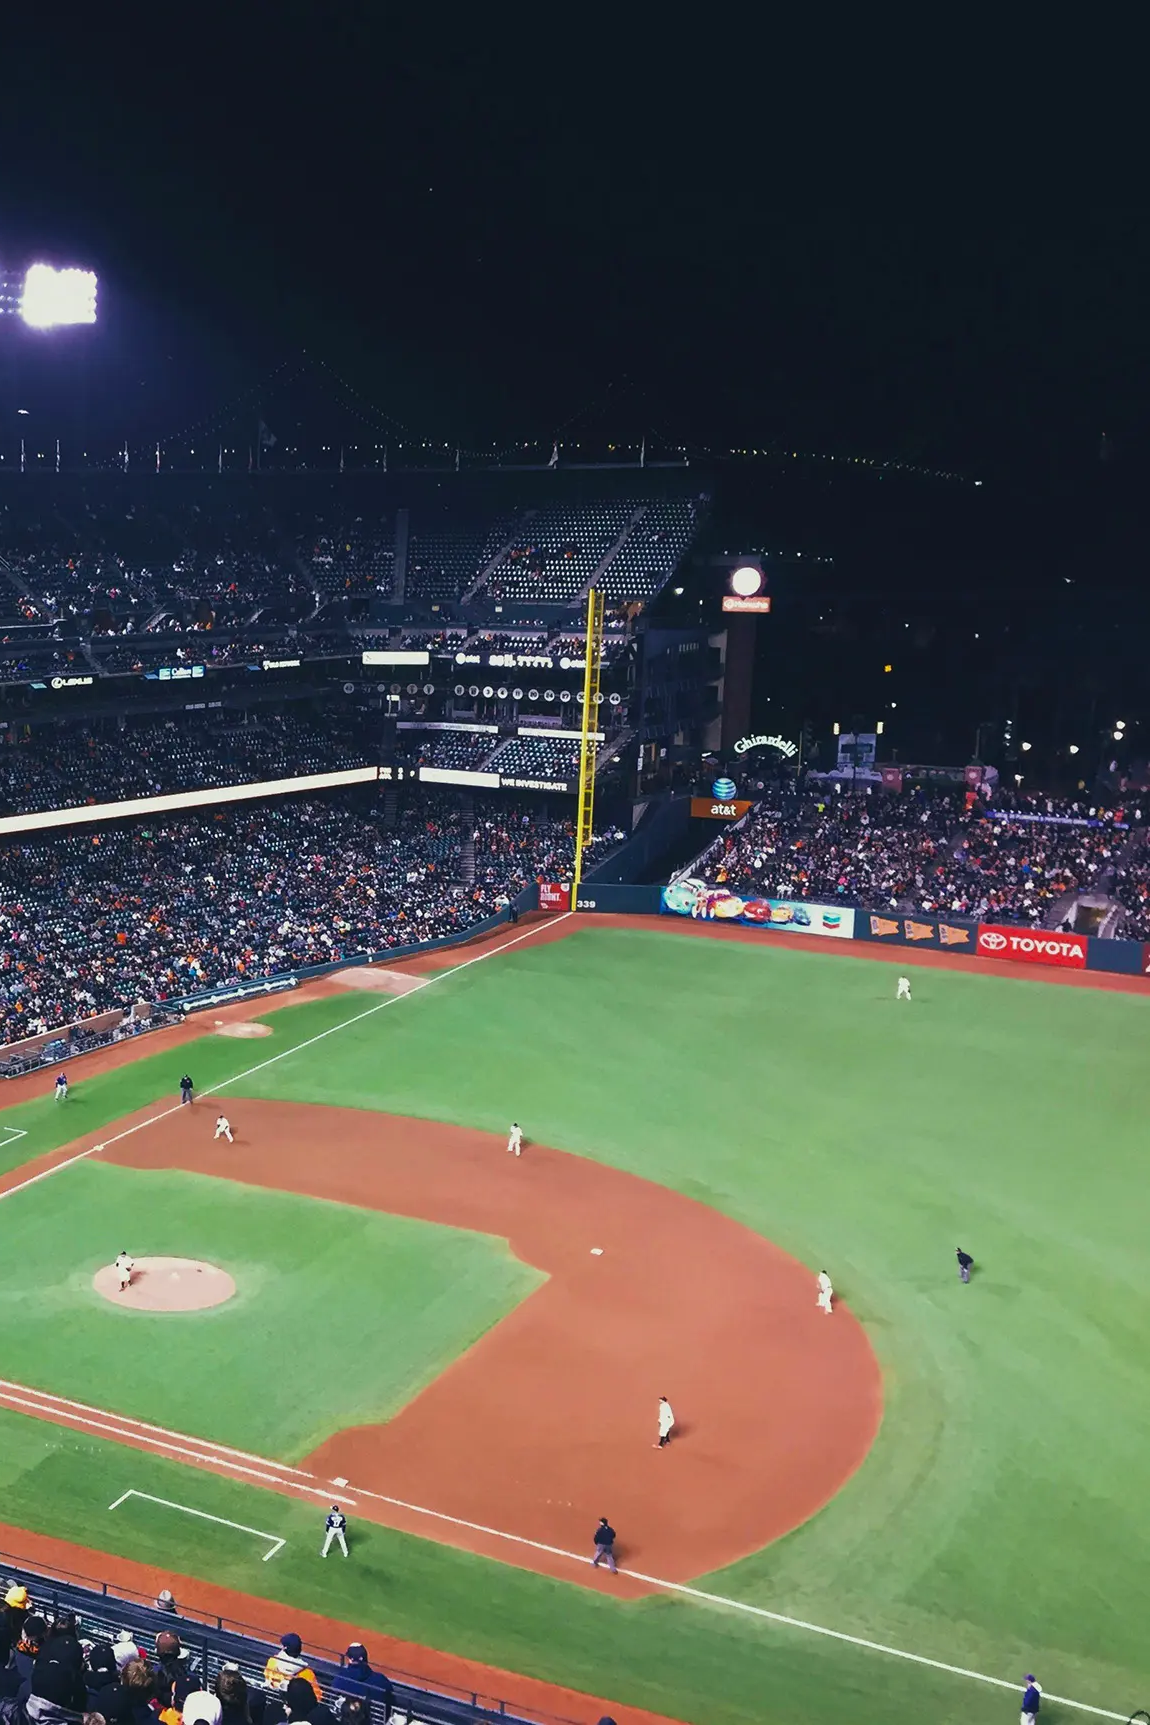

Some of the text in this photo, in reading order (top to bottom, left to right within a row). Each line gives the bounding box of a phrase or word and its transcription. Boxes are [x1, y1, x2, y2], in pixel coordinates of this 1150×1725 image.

[734, 734, 799, 757] Ghirardelli
[501, 778, 568, 791] WE INVESTIGATE
[711, 804, 737, 816] at&t
[576, 900, 596, 908] 339
[1010, 937, 1084, 959] TOYOTA
